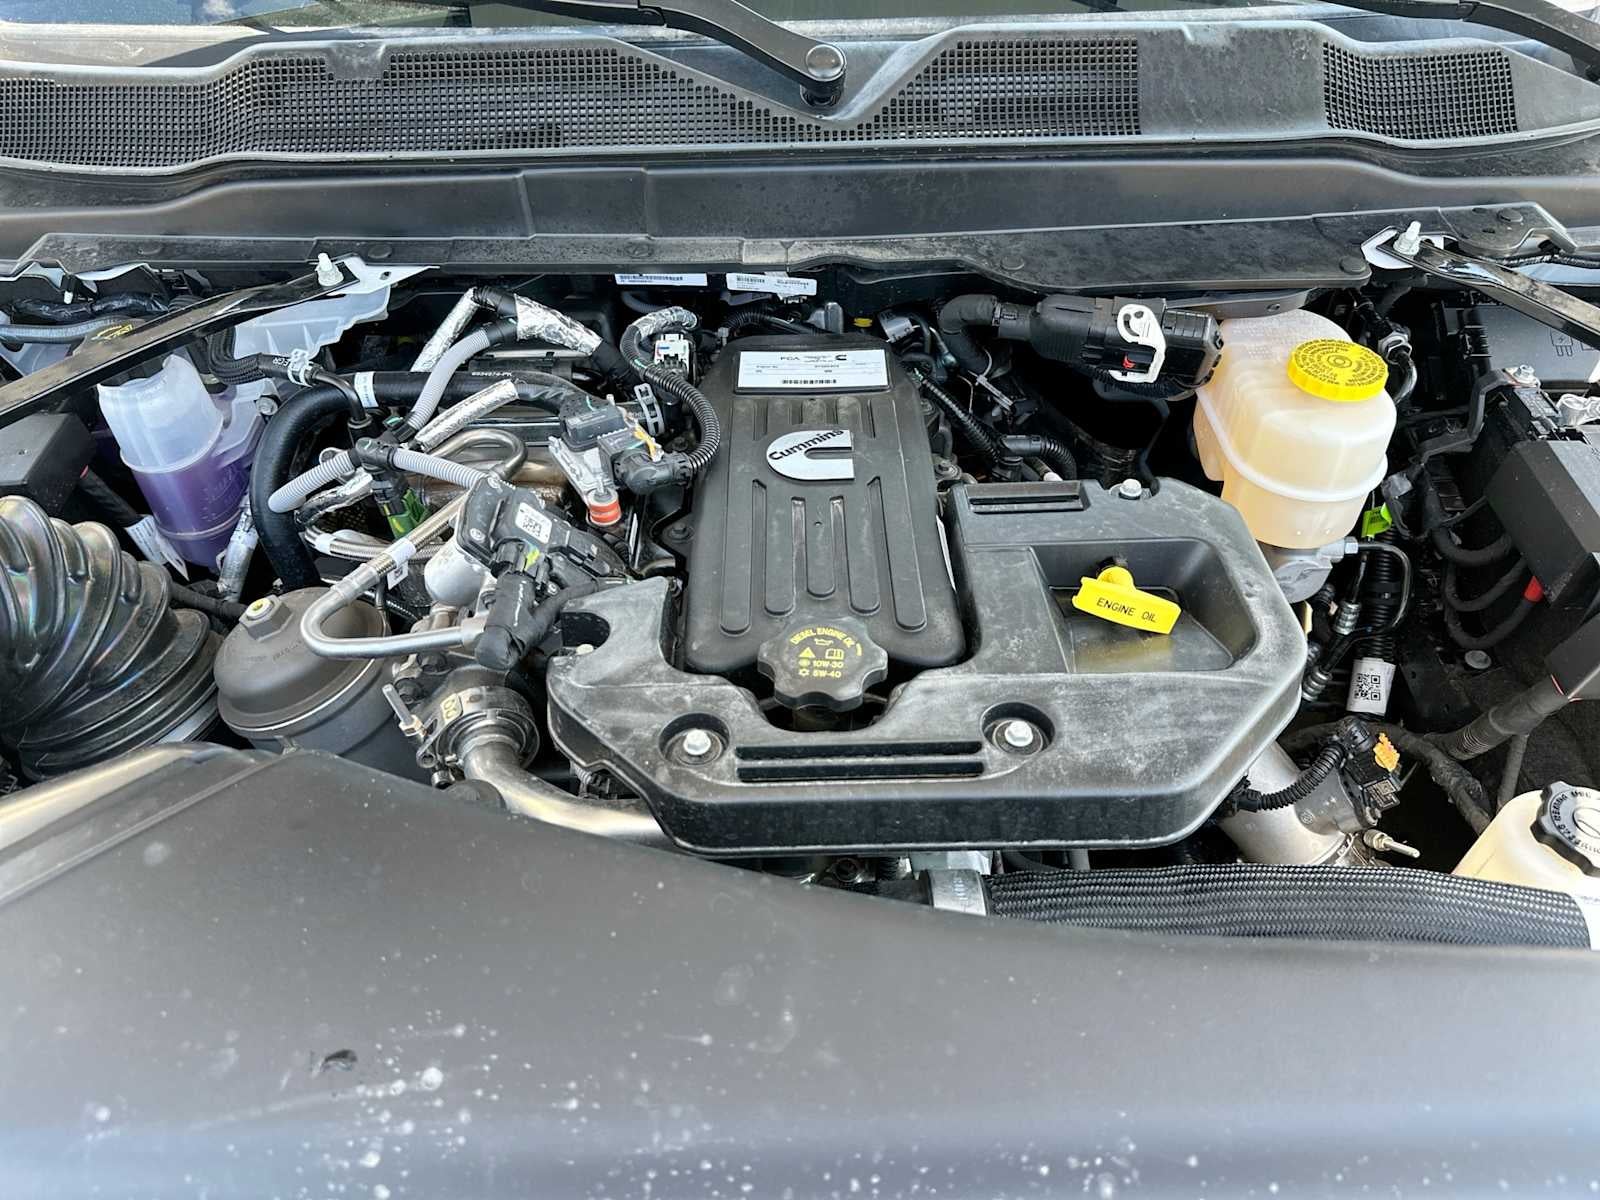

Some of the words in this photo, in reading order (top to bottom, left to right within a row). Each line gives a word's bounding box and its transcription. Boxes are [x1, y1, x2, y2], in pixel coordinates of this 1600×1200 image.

[768, 429, 844, 460] Cummins
[1096, 597, 1136, 617] ENGINE
[1141, 611, 1158, 623] OIL
[789, 628, 817, 645] DIESEL
[816, 627, 848, 641] ENGINE
[842, 636, 856, 649] OIL
[812, 660, 845, 669] 10W-30
[812, 669, 842, 679] 5W-40
